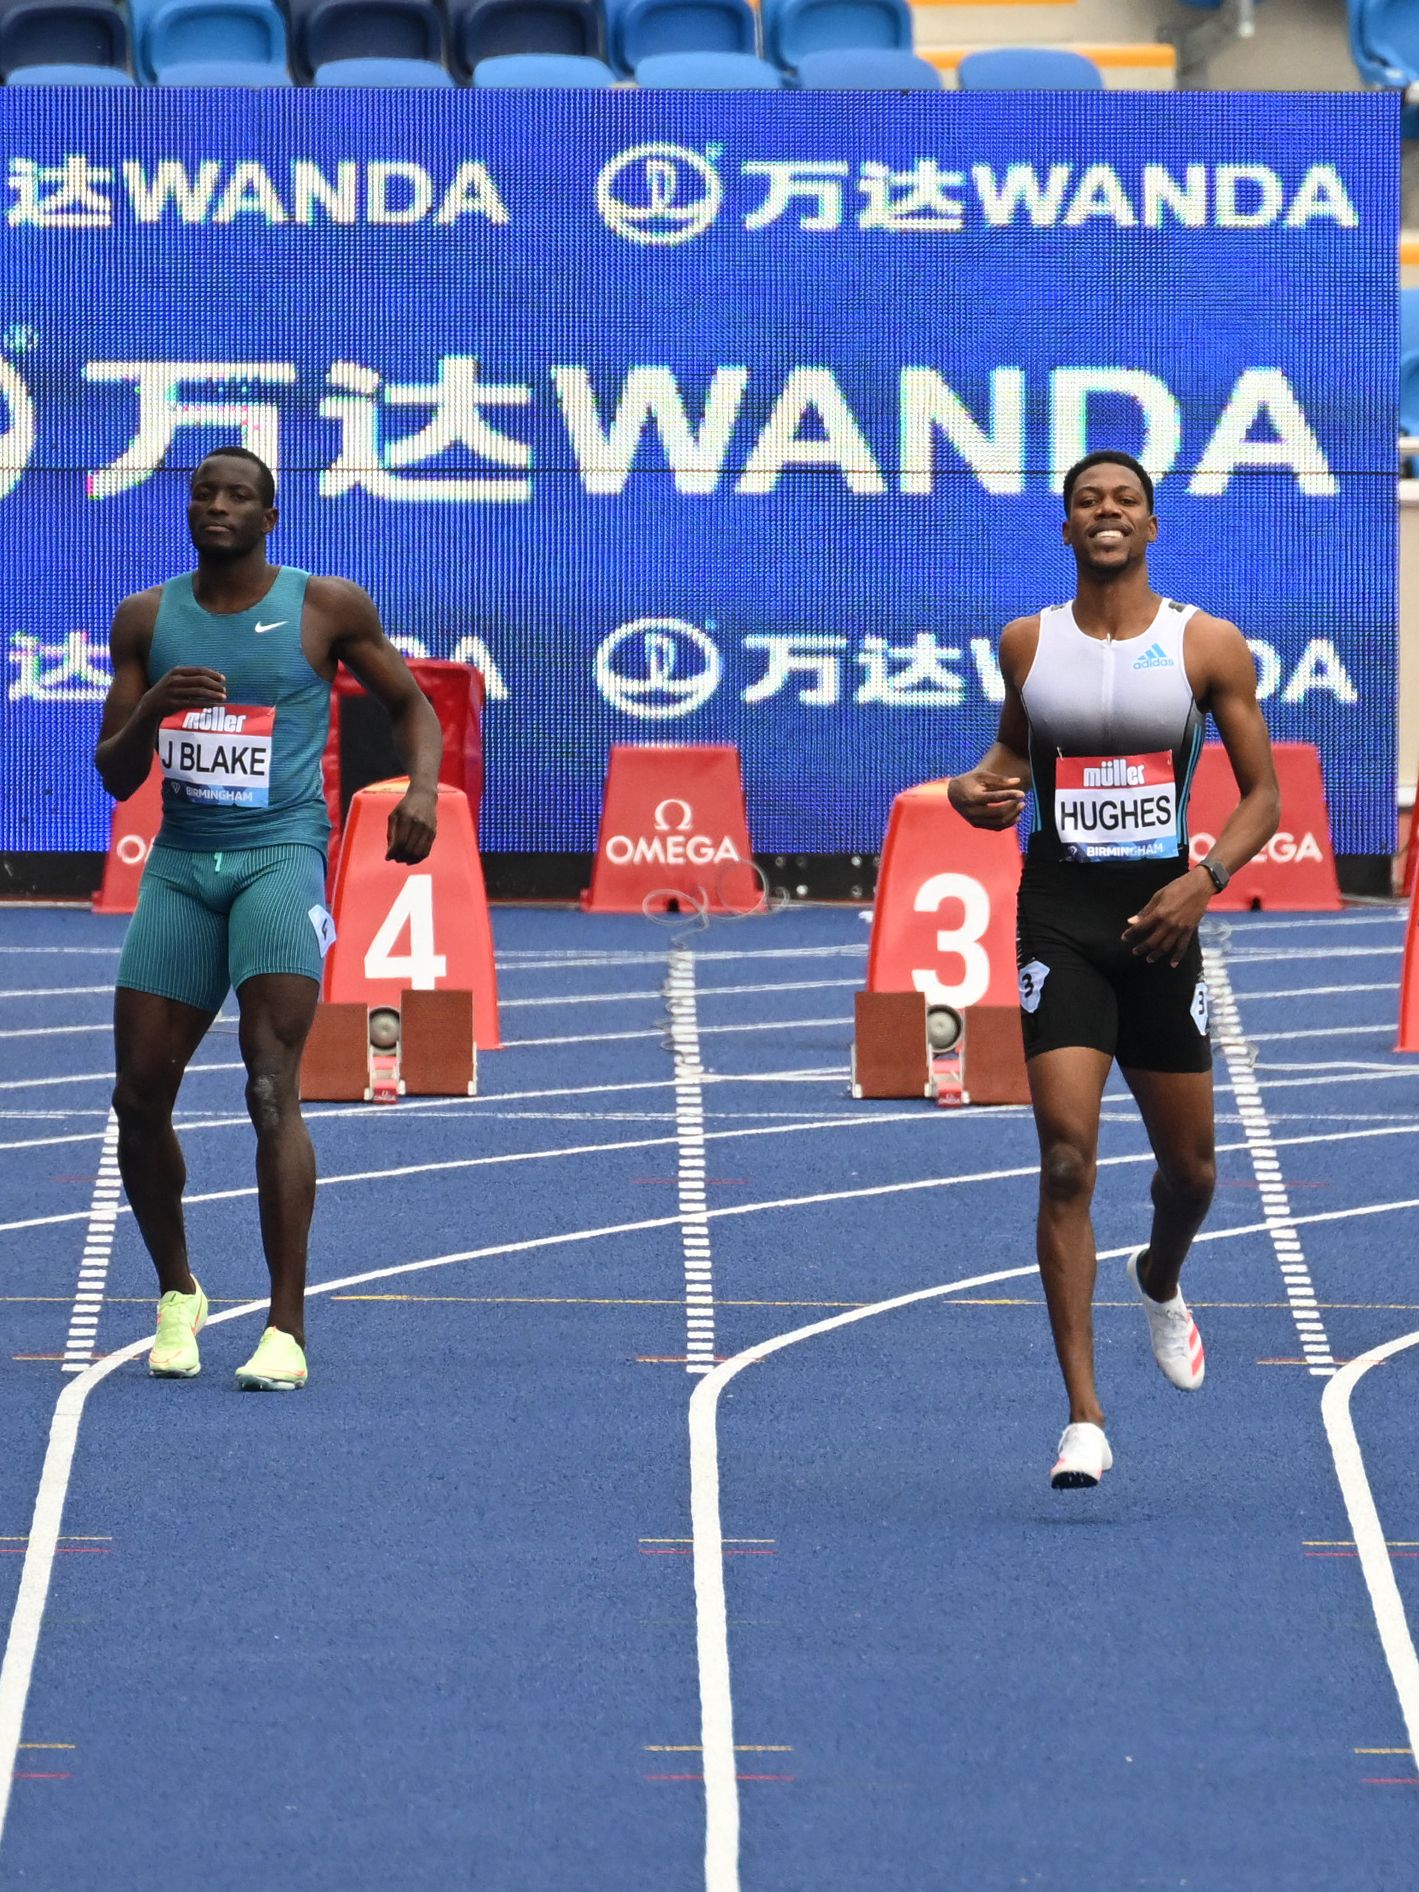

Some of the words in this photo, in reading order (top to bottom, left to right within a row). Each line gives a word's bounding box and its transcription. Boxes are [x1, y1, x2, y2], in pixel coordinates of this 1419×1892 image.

[121, 160, 510, 226] WANDA
[972, 162, 1360, 231] WANDA
[550, 365, 1341, 496] WANDA
[1133, 658, 1175, 670] adidas
[161, 740, 174, 769] J
[180, 742, 267, 776] BLAKE
[1083, 758, 1145, 787] müller
[185, 786, 254, 802] BIRMINGHAM
[1060, 795, 1172, 831] HUGHES
[605, 834, 740, 865] OMEGA
[1086, 843, 1164, 858] BIRMINGHAM
[364, 873, 447, 990] 4
[912, 872, 991, 1009] 3
[1021, 973, 1035, 998] 3
